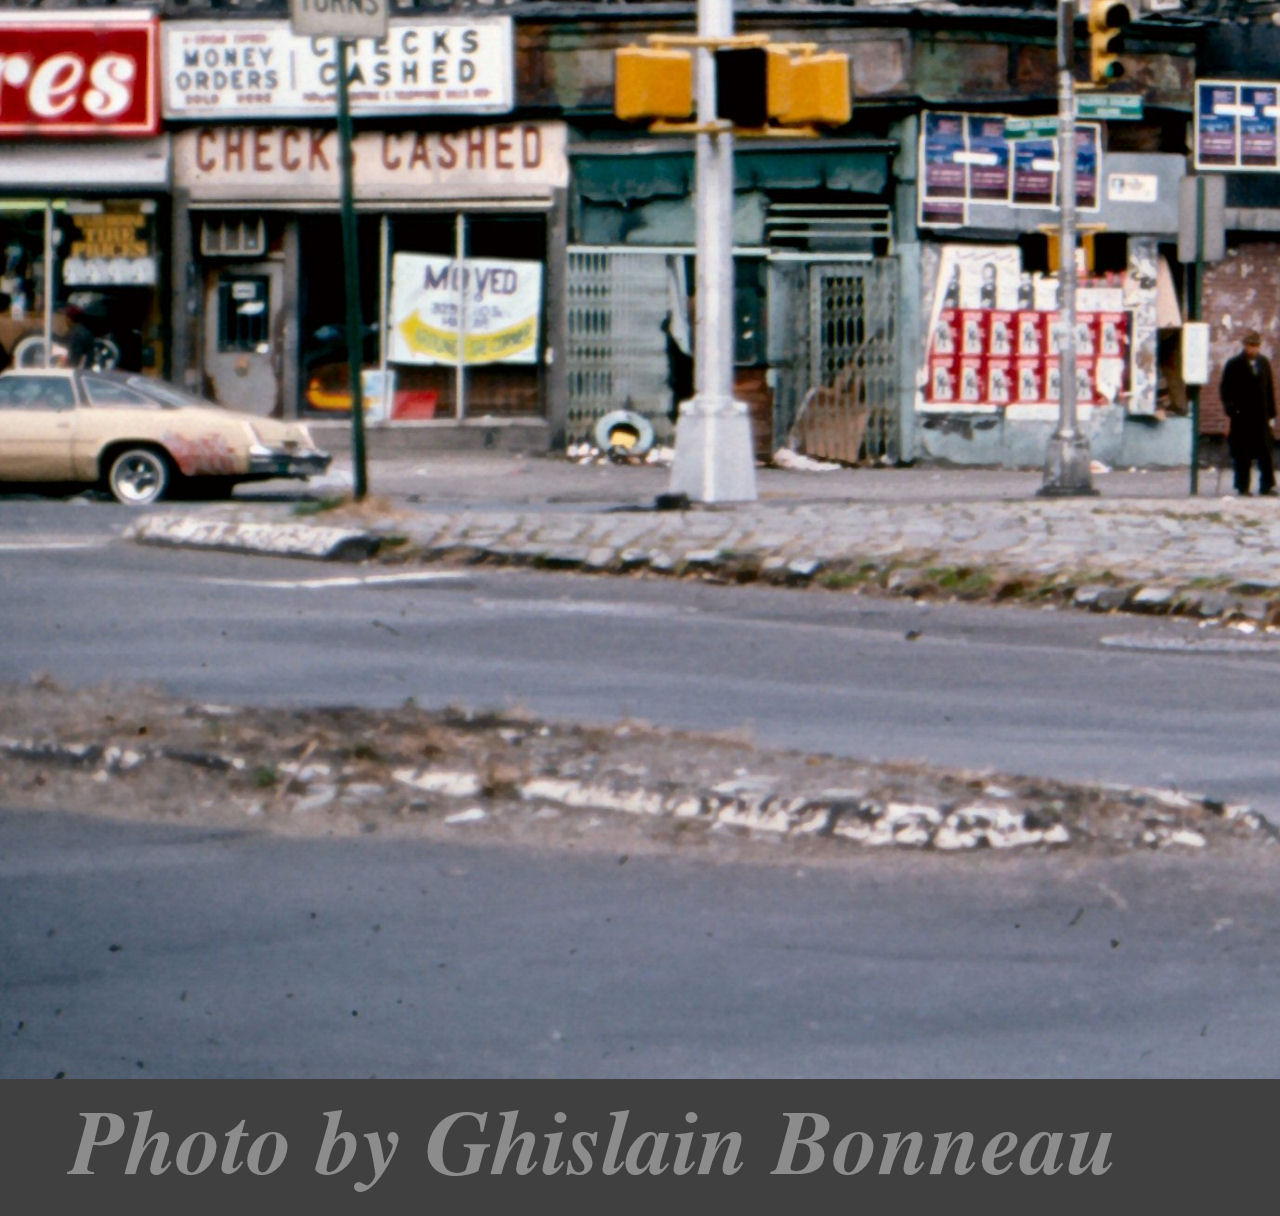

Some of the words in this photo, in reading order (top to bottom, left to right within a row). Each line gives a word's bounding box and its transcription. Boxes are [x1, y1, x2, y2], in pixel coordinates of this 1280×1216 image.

[183, 47, 273, 67] MONEY
[175, 70, 279, 91] ORDERS
[318, 59, 477, 86] CASHED
[194, 129, 357, 172] CHECK
[381, 124, 544, 170] CASHED
[424, 263, 518, 302] MOVED
